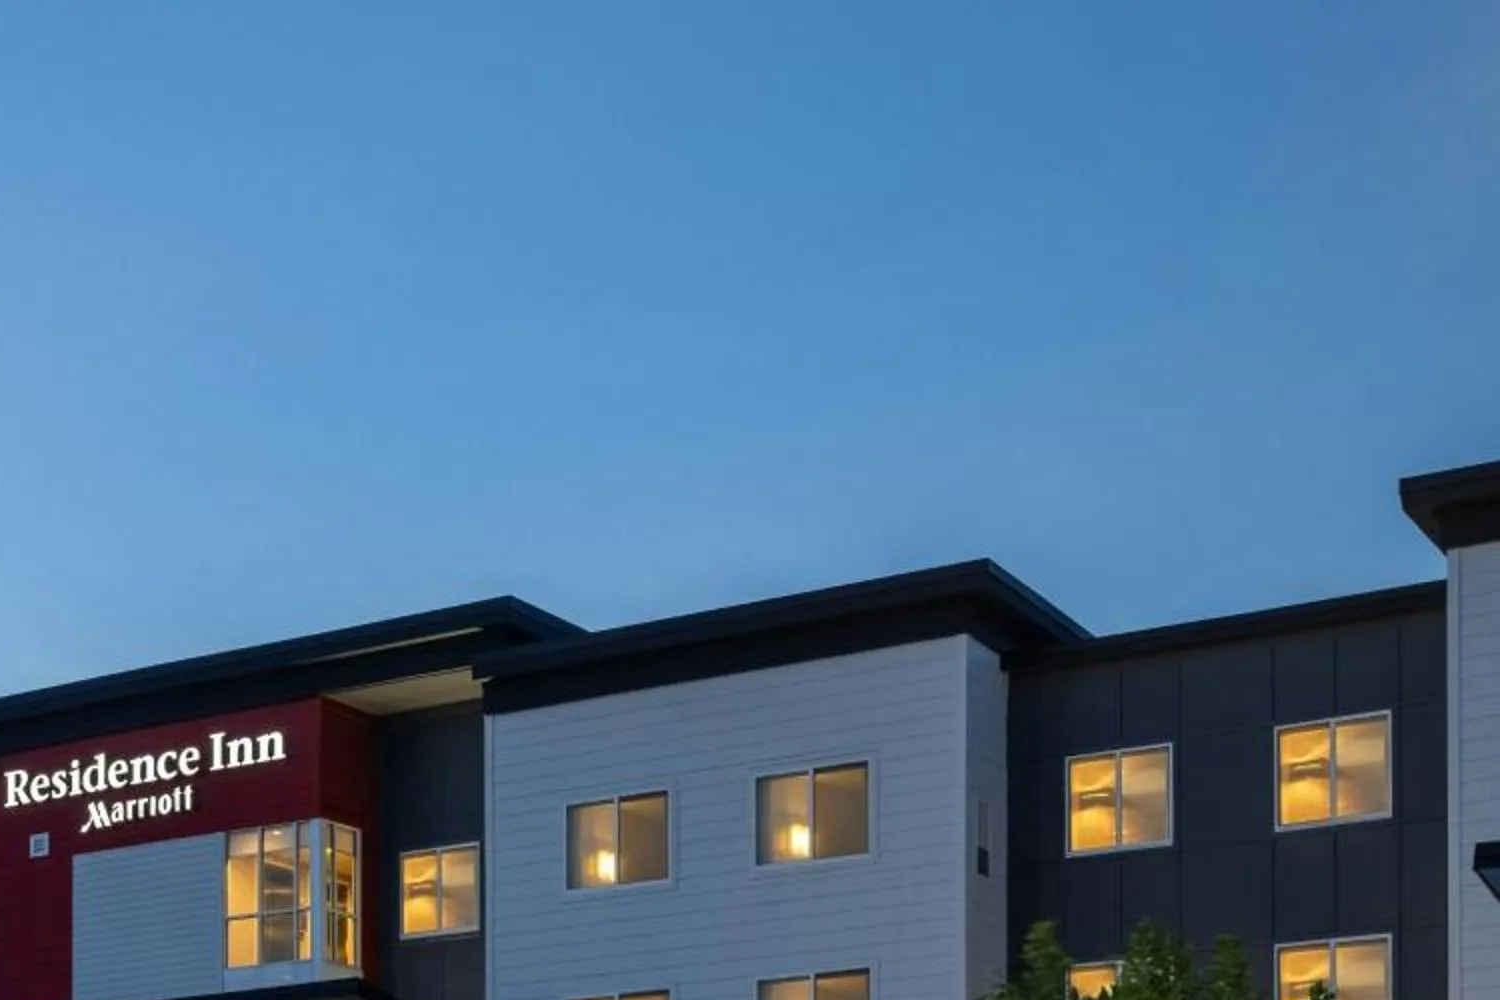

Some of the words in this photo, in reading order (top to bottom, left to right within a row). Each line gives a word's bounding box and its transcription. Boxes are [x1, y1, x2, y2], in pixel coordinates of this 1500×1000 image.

[3, 746, 201, 808] Residence
[208, 730, 287, 772] Inn
[79, 784, 193, 834] Marriott
